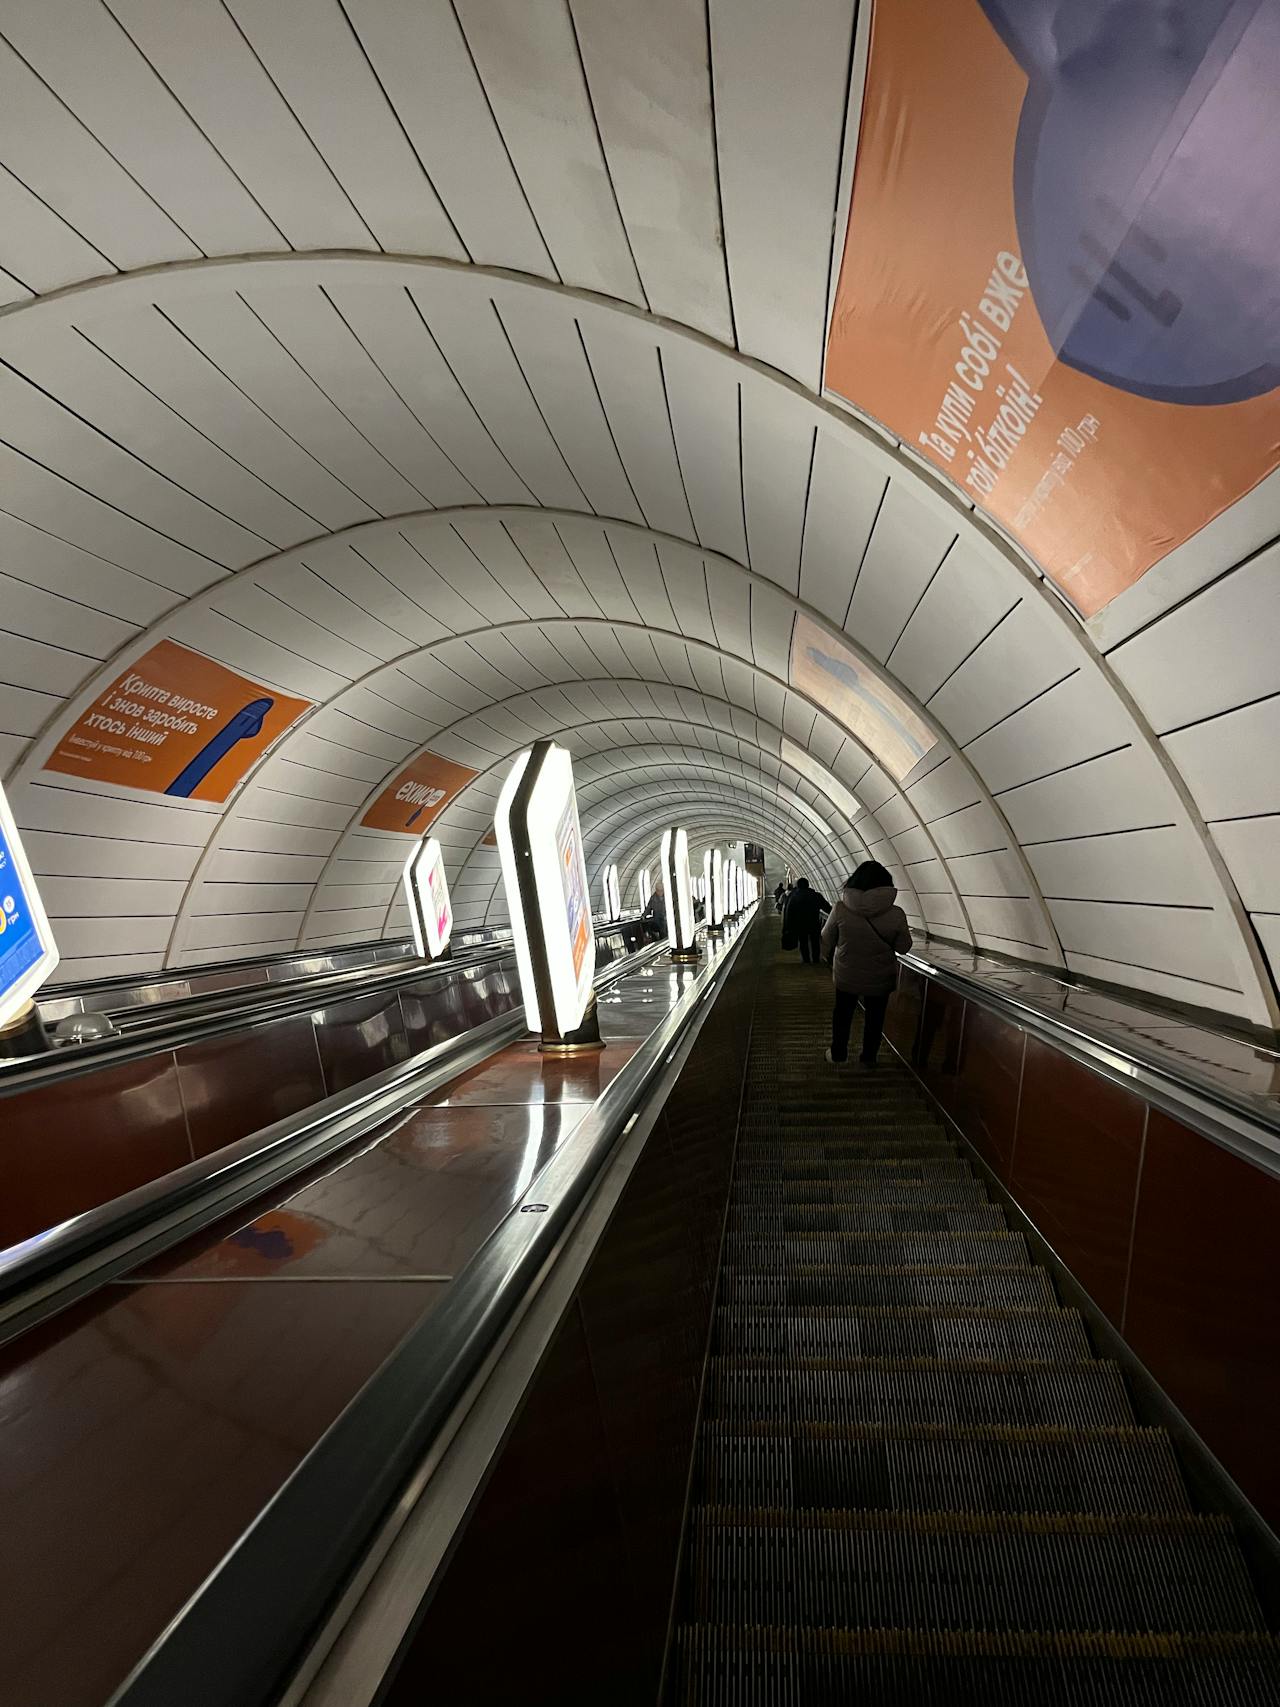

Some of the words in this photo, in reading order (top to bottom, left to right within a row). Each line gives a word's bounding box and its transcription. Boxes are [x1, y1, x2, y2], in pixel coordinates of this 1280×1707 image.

[978, 251, 1029, 333] вже
[955, 311, 1001, 391] собі
[935, 381, 976, 443] купи
[975, 363, 1043, 470] біткоїн!
[1057, 427, 1086, 458] 100
[1077, 413, 1101, 443] грн
[917, 431, 956, 463] Та
[966, 450, 999, 497] той
[101, 690, 117, 707] і
[109, 697, 146, 718] знов
[142, 709, 199, 735] заробить
[119, 673, 171, 704] Крипта
[167, 695, 219, 720] виросте
[83, 713, 126, 735] хтось
[125, 722, 169, 746] інший
